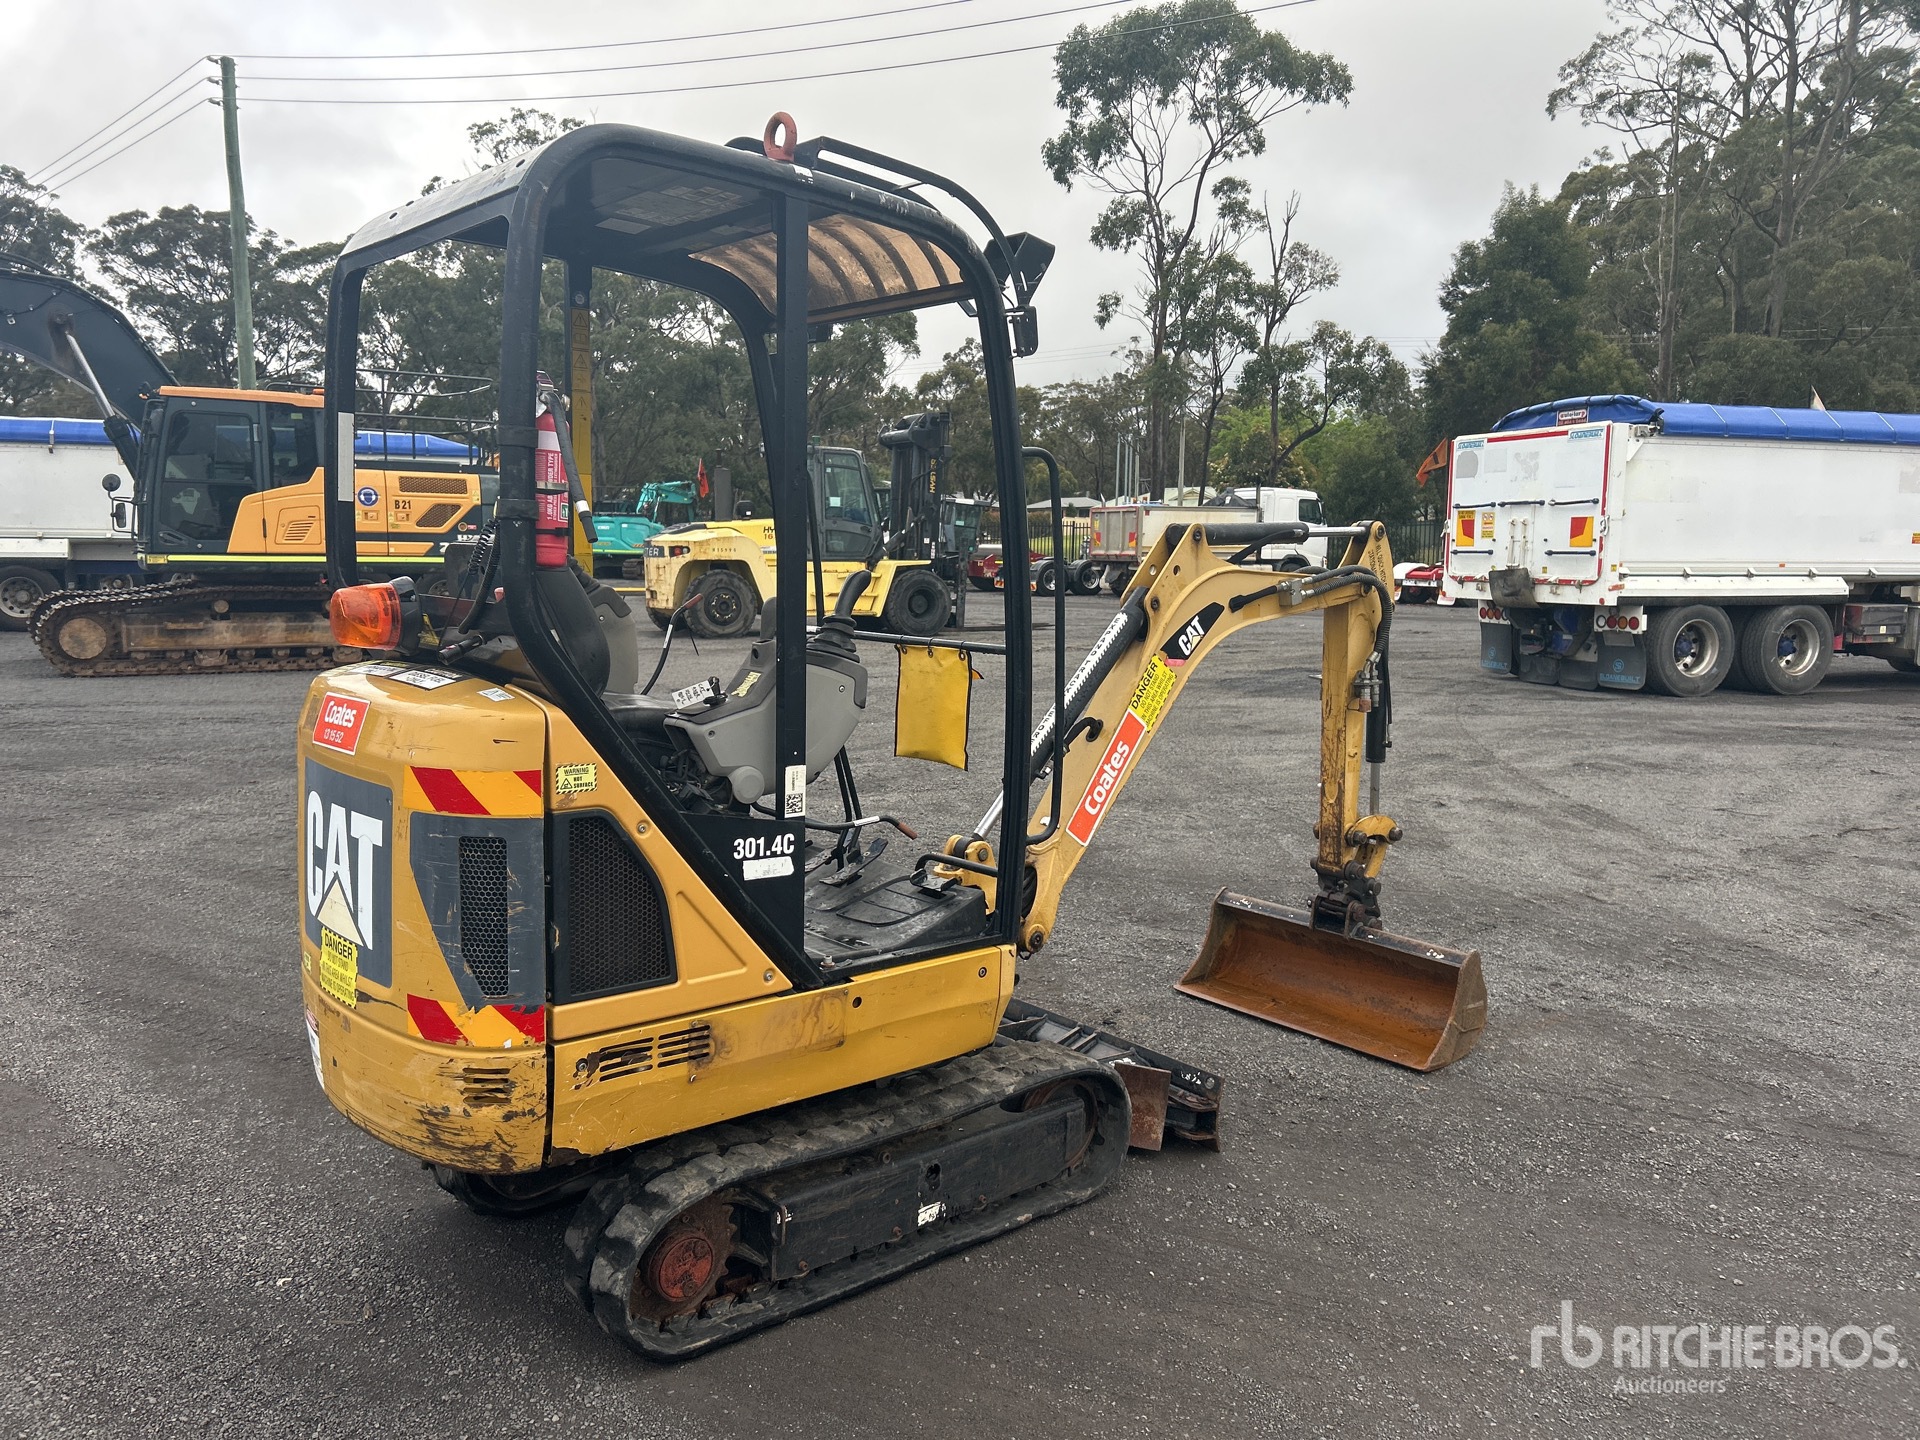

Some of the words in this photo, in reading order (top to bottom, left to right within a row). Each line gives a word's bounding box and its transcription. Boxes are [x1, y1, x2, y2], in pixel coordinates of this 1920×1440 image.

[402, 500, 412, 509] 21
[1178, 616, 1205, 656] CAT
[1132, 662, 1158, 709] DANGER
[324, 700, 357, 728] Coates
[335, 731, 344, 743] 52
[564, 767, 590, 775] WARNING
[1085, 740, 1130, 816] Coates
[733, 833, 795, 860] 301.4C
[307, 790, 383, 950] CAT
[325, 932, 353, 962] DANGER
